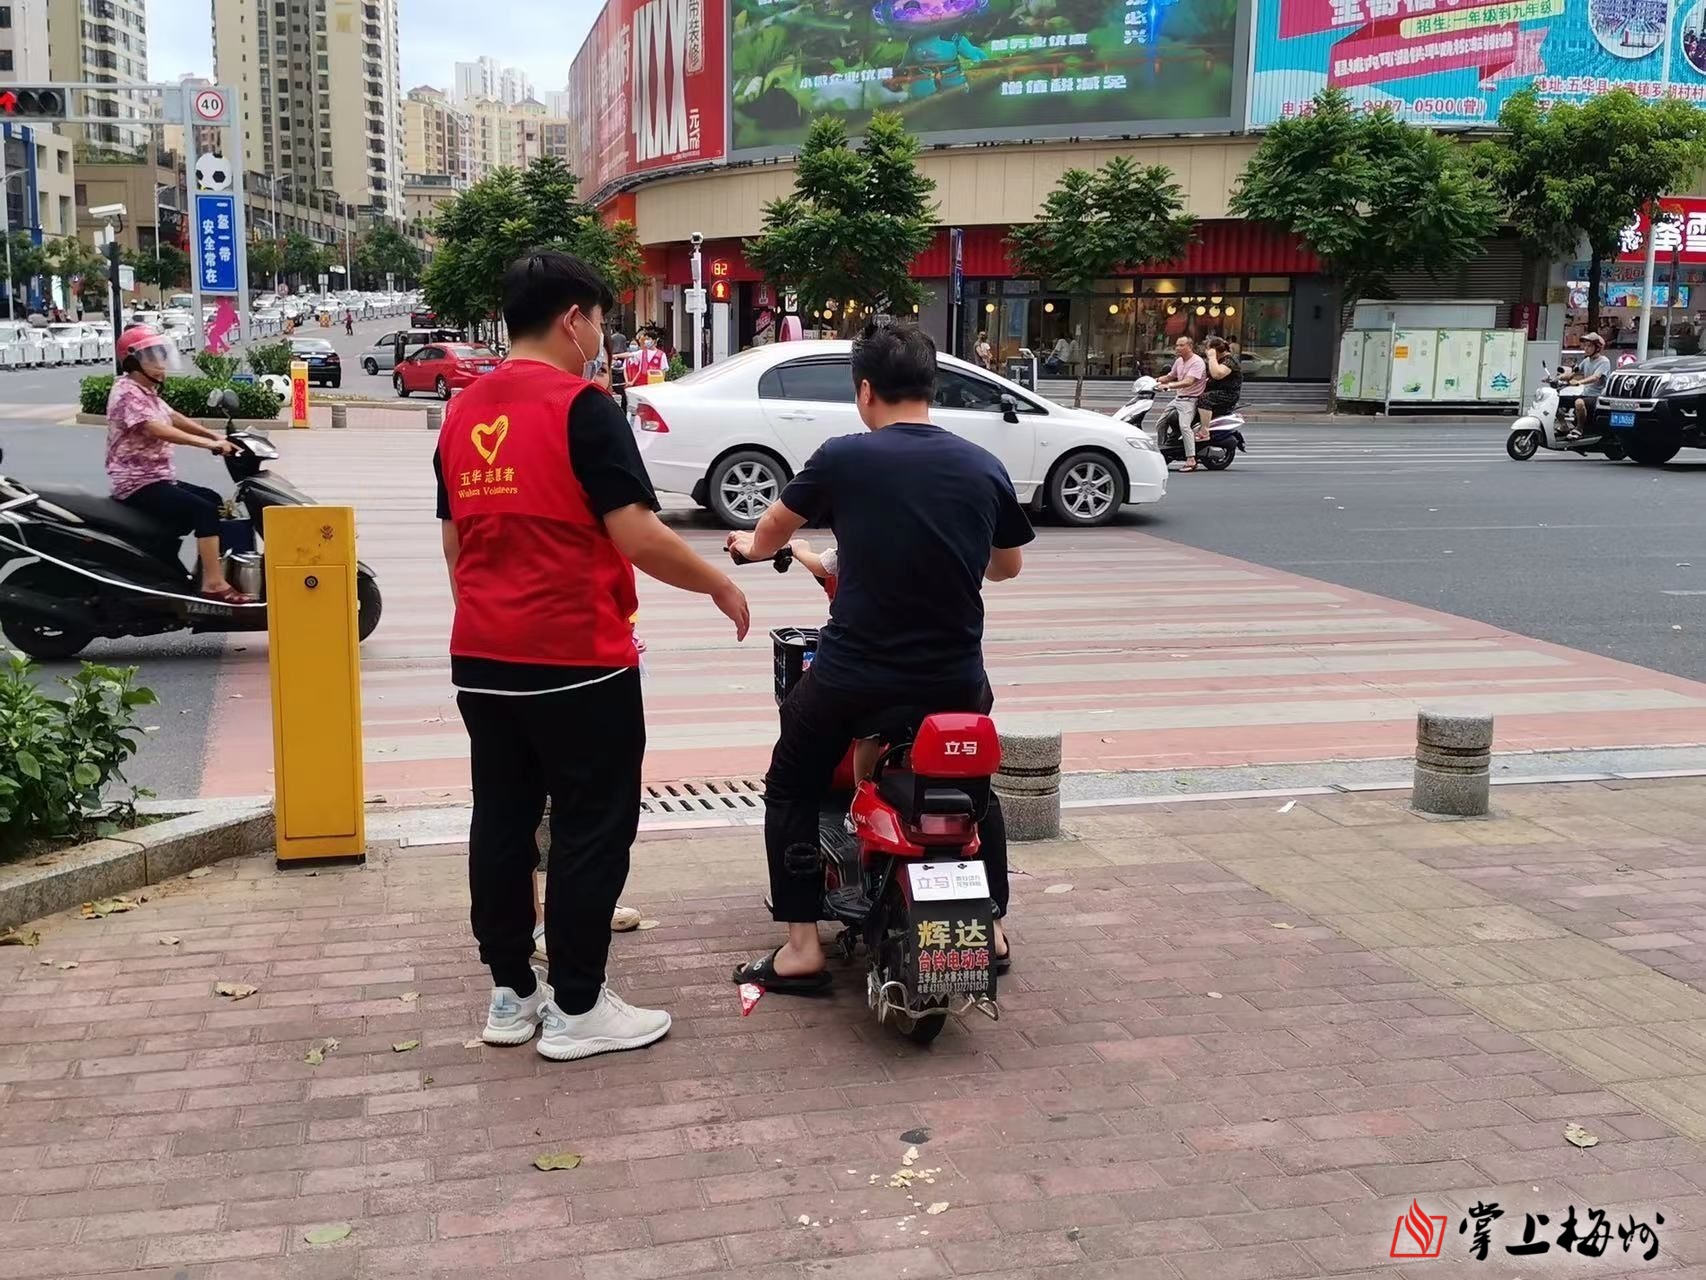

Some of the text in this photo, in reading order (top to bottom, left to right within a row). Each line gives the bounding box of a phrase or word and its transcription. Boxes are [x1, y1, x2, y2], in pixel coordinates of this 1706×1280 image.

[1001, 75, 1127, 95] 增值税减免
[201, 98, 219, 110] 40
[216, 202, 231, 262] 一盔一带
[202, 219, 218, 284] 安全常在
[713, 263, 728, 276] 82
[944, 741, 977, 755] 立马
[916, 876, 950, 890] 立马
[917, 918, 989, 949] 辉达
[917, 947, 990, 973] 台铃电动车
